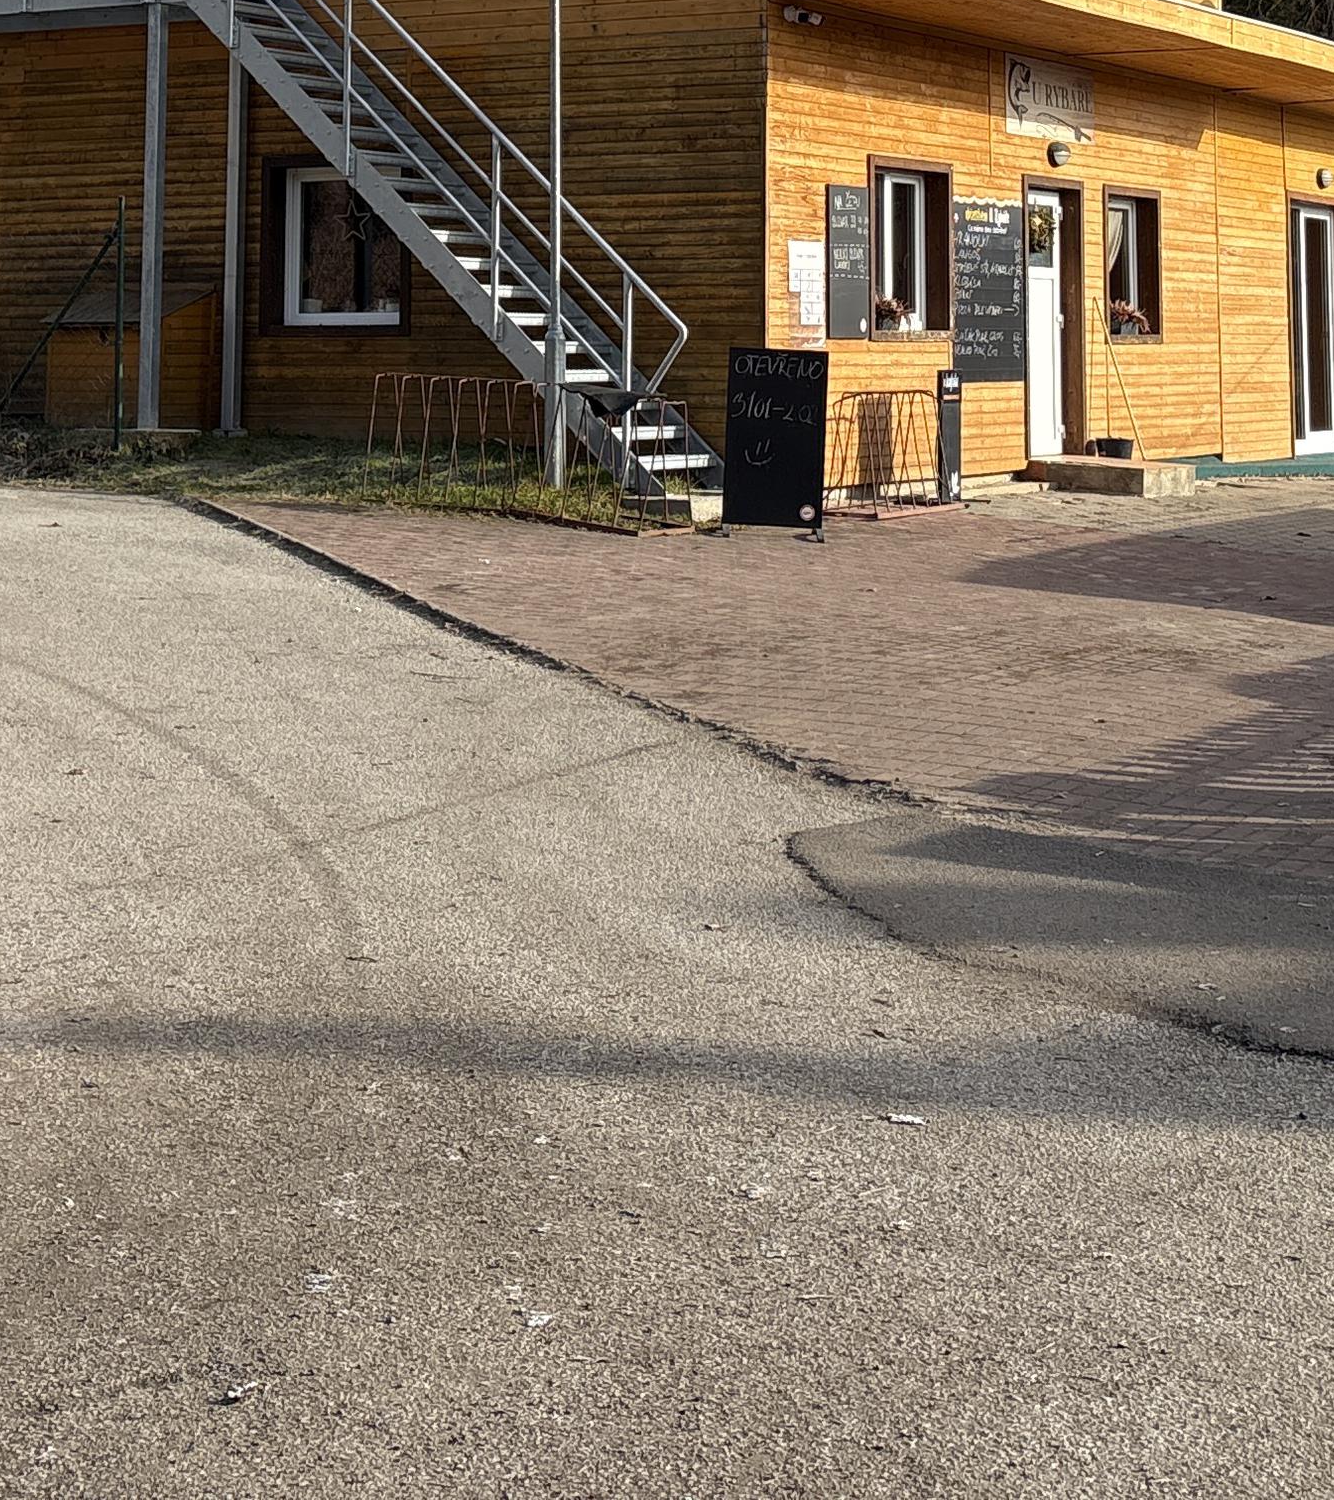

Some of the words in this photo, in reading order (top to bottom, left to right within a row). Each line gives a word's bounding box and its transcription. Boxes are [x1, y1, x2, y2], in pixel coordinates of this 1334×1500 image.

[1032, 81, 1043, 105] U
[1044, 83, 1093, 114] RYBÁŘE
[734, 353, 824, 380] OTEVŘENO
